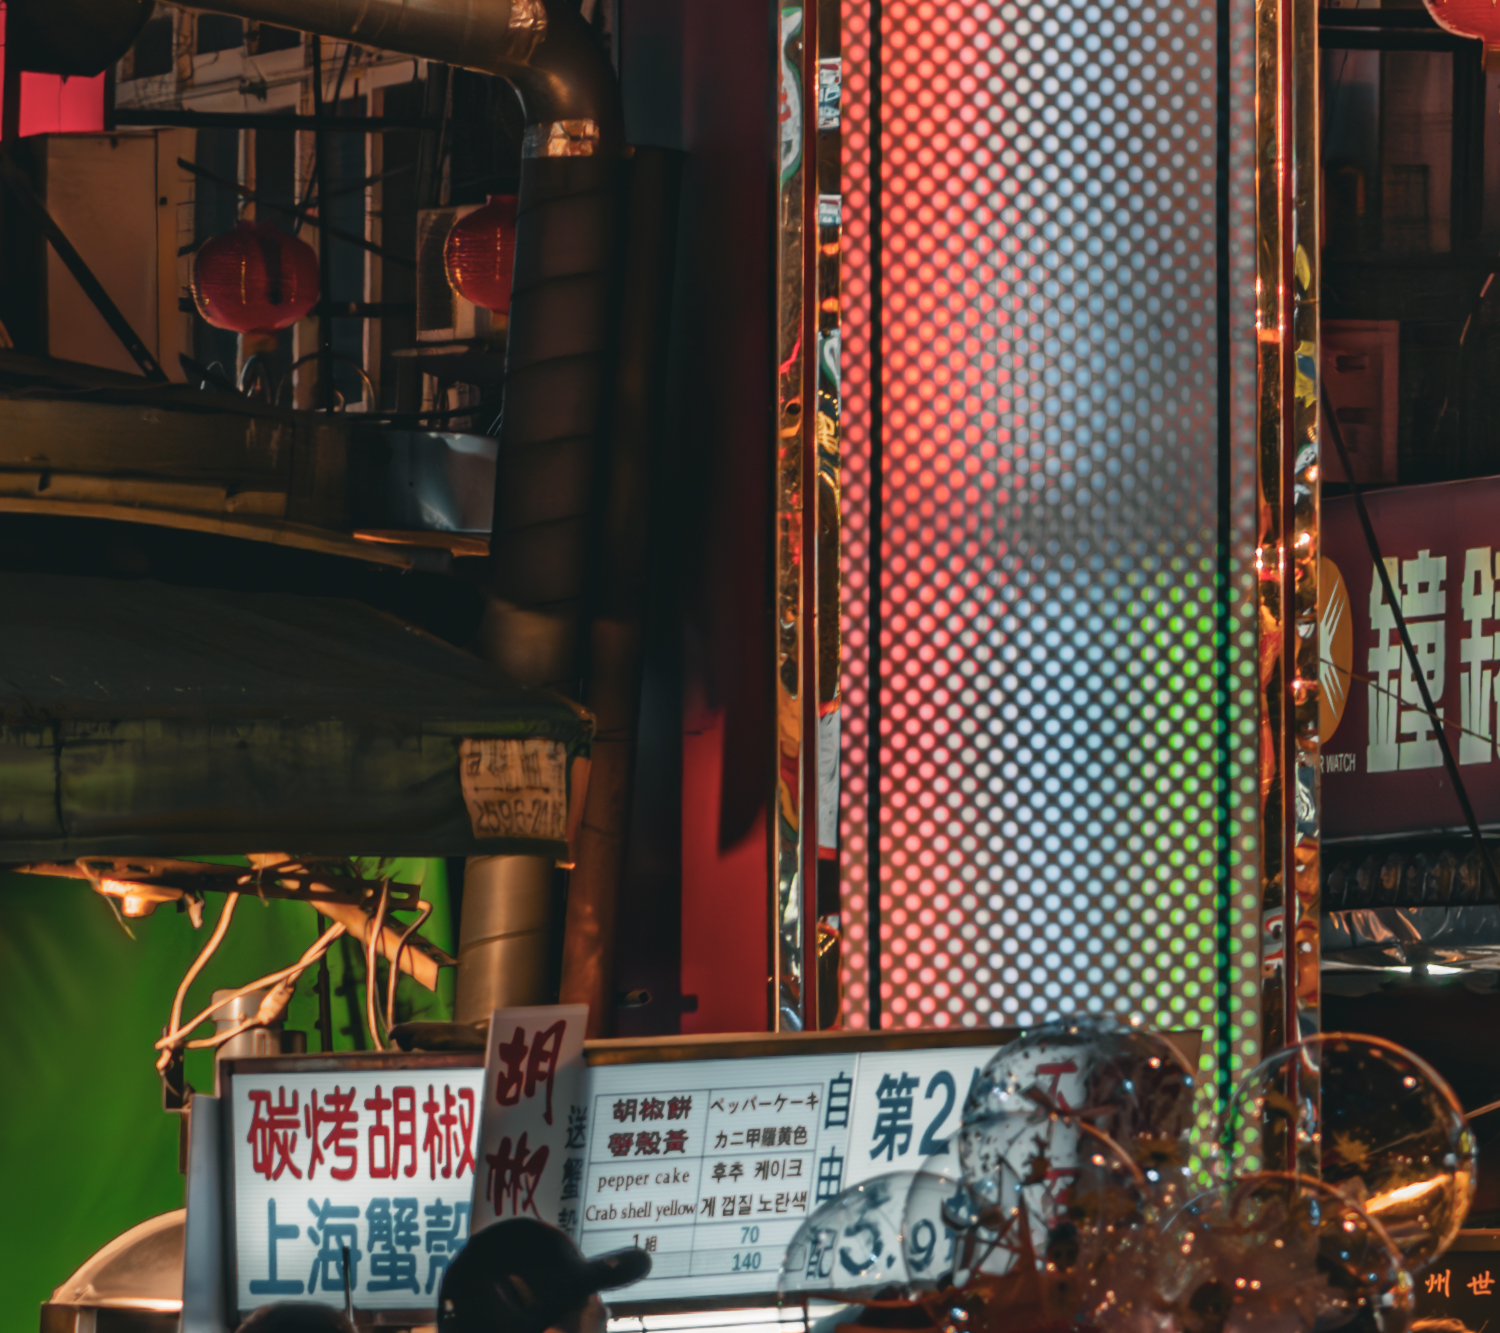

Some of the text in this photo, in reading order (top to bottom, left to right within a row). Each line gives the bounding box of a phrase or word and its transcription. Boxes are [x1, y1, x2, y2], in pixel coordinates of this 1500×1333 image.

[1326, 753, 1356, 773] WATCH
[613, 1096, 692, 1122] 胡椒餅
[711, 1092, 820, 1114] ペッパーケーキ
[247, 1084, 475, 1181] 碳烤胡椒
[598, 1167, 690, 1192] pepper cake
[711, 1159, 803, 1183] 후추 케이크
[585, 1200, 696, 1223] Crab shell yellow
[700, 1196, 716, 1217] 게
[757, 1191, 808, 1213] 노란색
[741, 1226, 760, 1244] 70
[732, 1252, 762, 1271] 140
